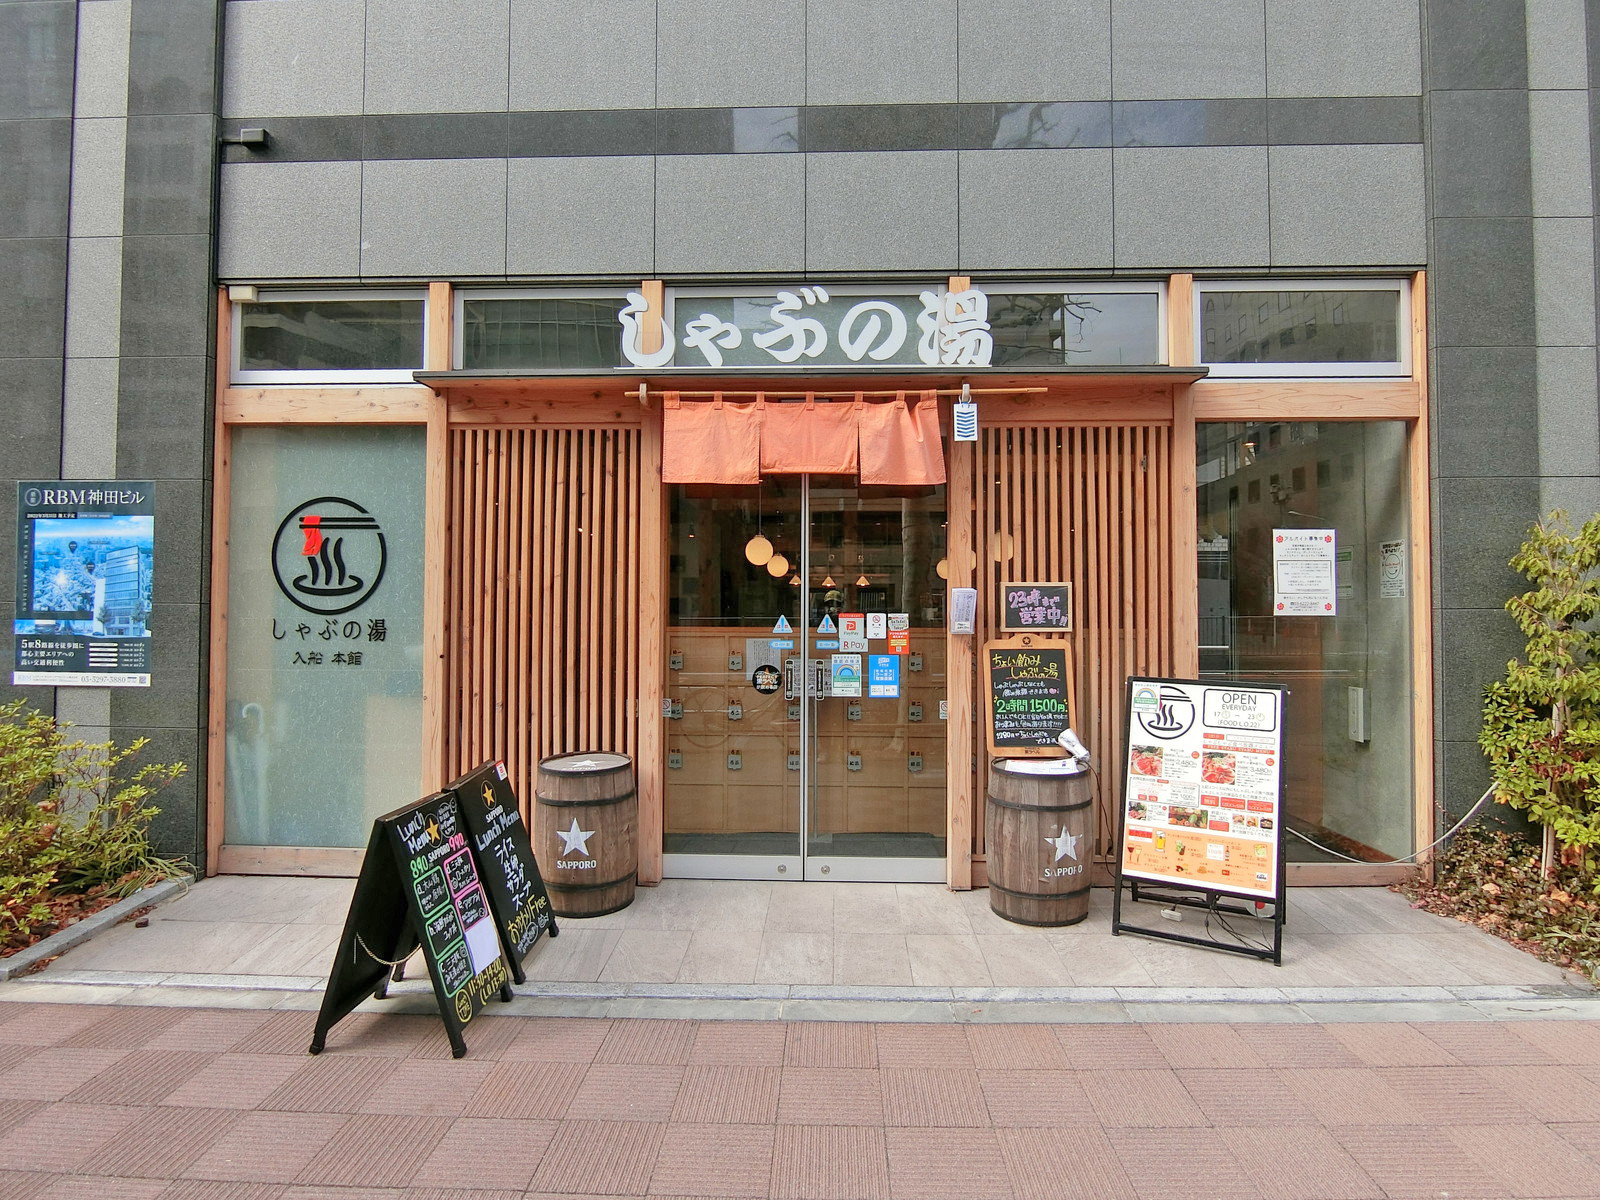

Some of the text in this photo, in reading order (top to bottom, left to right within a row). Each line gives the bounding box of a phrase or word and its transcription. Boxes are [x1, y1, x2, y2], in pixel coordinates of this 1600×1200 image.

[618, 285, 994, 367] しゃぶの湯
[1008, 588, 1060, 608] 23時まで
[272, 618, 388, 642] しゃぶの湯
[850, 641, 865, 649] Pay
[331, 651, 363, 666] 本館
[1010, 662, 1059, 679] しゃぶの湯
[996, 698, 1065, 713] 2時間 1500円
[1221, 703, 1257, 712] EVERYDAY
[1222, 693, 1257, 705] OPEN
[396, 810, 426, 842] Lunch
[475, 819, 502, 851] Lunch
[494, 836, 515, 865] ライス
[556, 859, 597, 869] SAPPORO
[506, 862, 524, 894] サラダ
[512, 880, 532, 911] スープ
